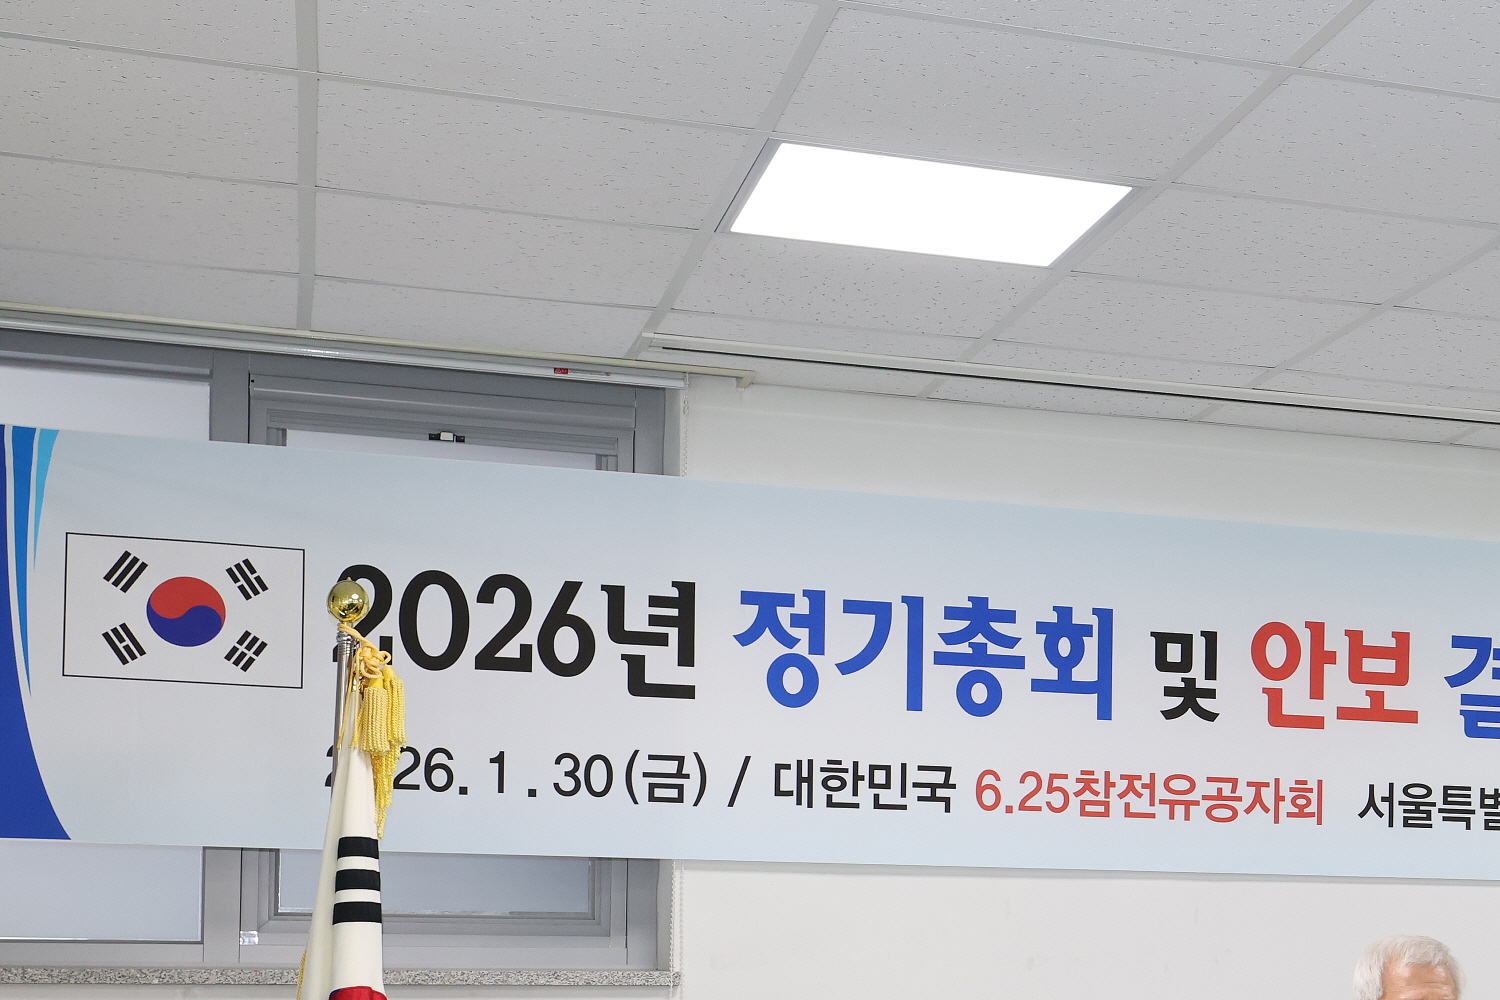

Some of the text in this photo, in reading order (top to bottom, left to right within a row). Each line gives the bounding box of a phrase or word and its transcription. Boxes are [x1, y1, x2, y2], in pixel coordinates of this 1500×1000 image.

[733, 589, 1114, 721] 정기총회
[1150, 630, 1220, 723] 및
[1250, 620, 1419, 729] 안보
[553, 749, 707, 807] 30(금)
[774, 758, 956, 814] 대한민국
[974, 769, 1325, 826] 6.25참전유공자회
